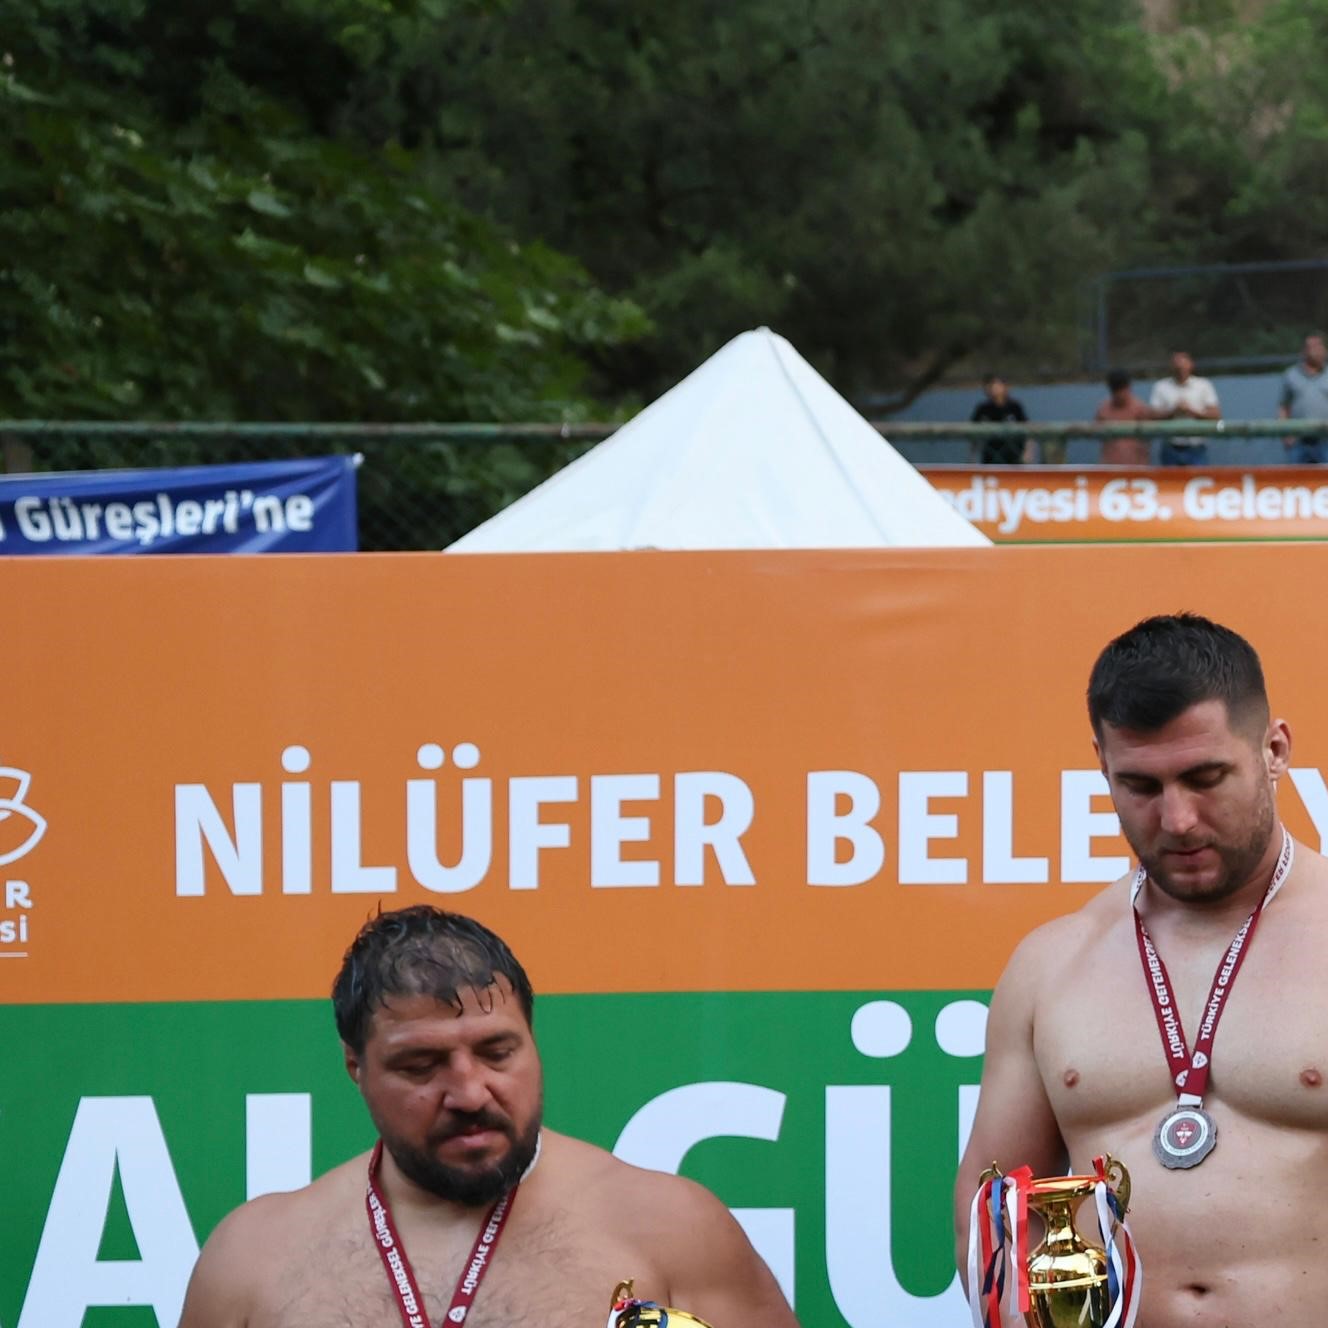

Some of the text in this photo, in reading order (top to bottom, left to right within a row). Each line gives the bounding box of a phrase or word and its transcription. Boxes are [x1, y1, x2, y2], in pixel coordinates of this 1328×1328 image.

[14, 490, 314, 545] Güreşleri'ne
[1099, 476, 1172, 523] 63.
[173, 742, 757, 897] NİLÜFER
[1200, 988, 1224, 1041] TÜRKİYE
[387, 1248, 418, 1317] GELENEKSEL
